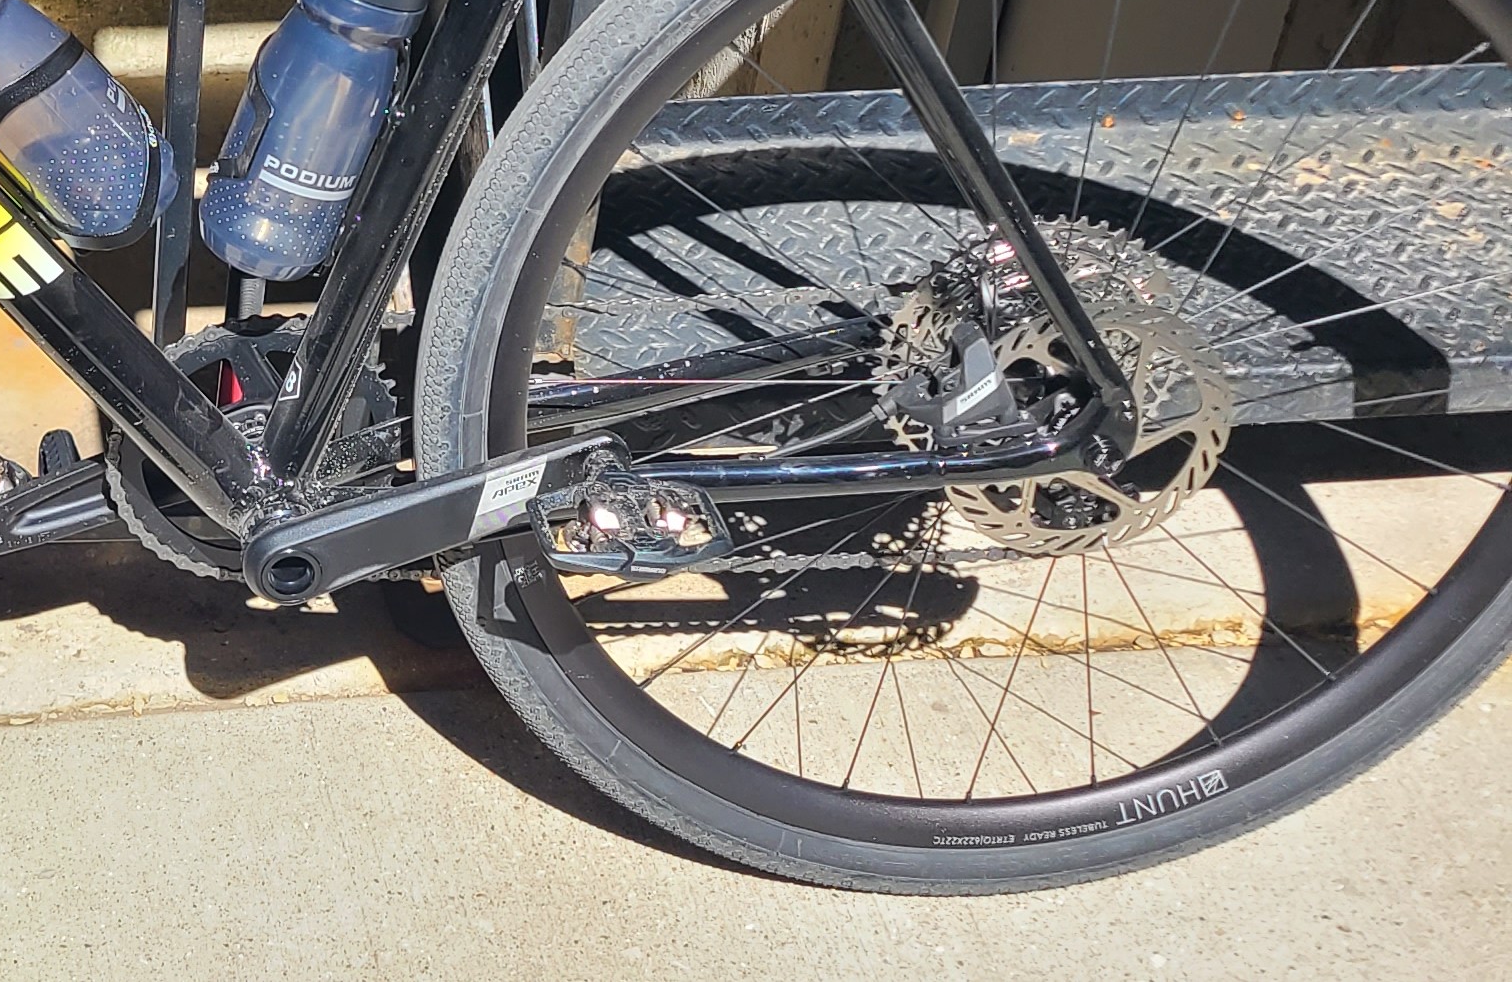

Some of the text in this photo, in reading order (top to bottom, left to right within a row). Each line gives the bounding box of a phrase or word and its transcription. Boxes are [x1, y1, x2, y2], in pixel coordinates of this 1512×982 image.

[263, 154, 358, 189] PODIUM
[491, 477, 537, 500] APEX
[1116, 778, 1201, 825] HUNT
[1023, 829, 1057, 842] READY
[1058, 819, 1109, 838] TUBELESS
